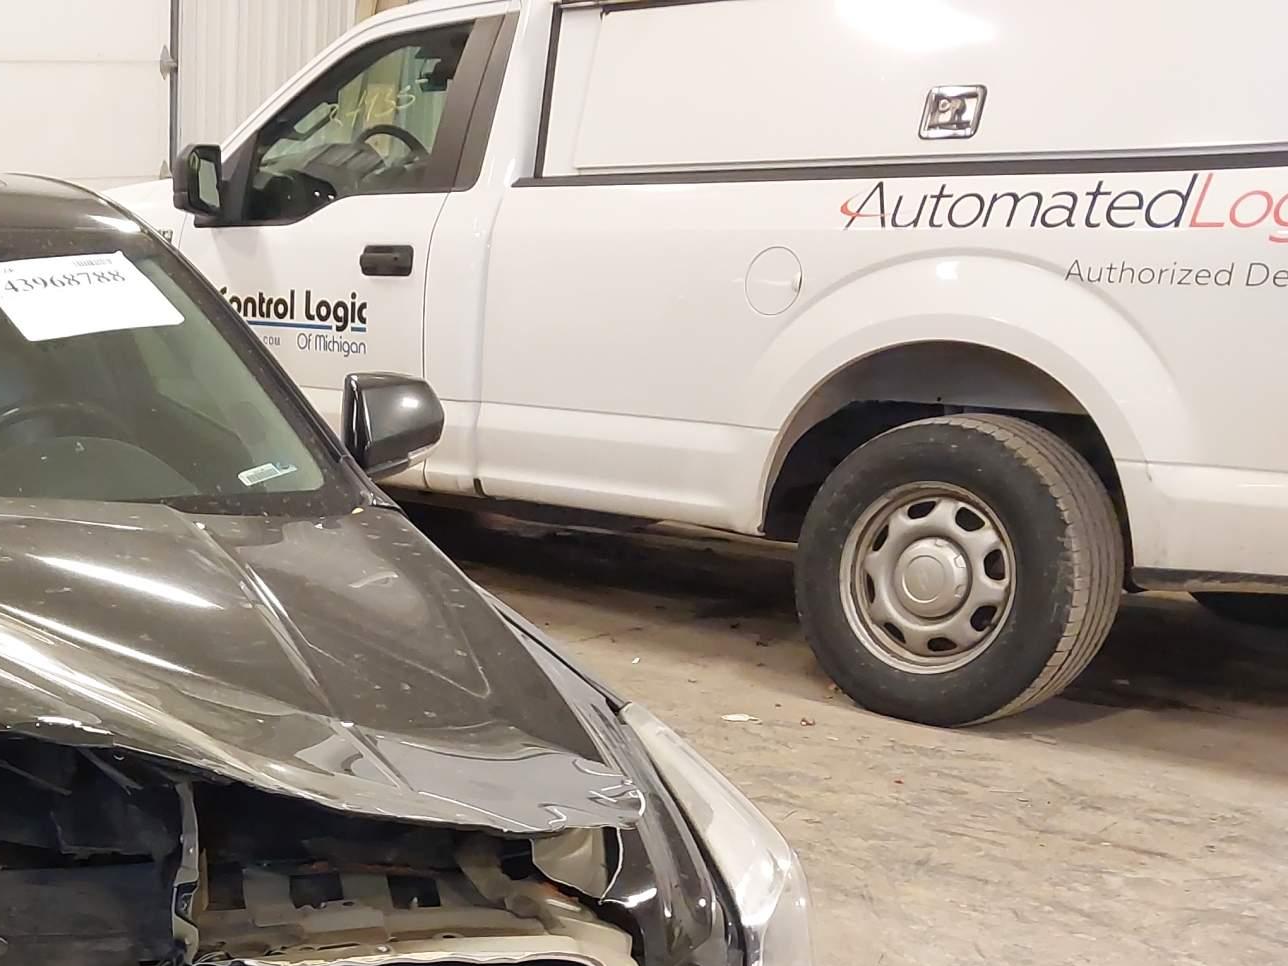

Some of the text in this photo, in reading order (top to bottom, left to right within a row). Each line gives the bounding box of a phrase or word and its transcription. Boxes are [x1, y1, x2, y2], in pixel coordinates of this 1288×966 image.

[3, 268, 127, 293] 43968788
[1064, 259, 1235, 287] Authorized
[220, 286, 368, 333] ontrol Logic
[296, 332, 367, 358] Of Michigan
